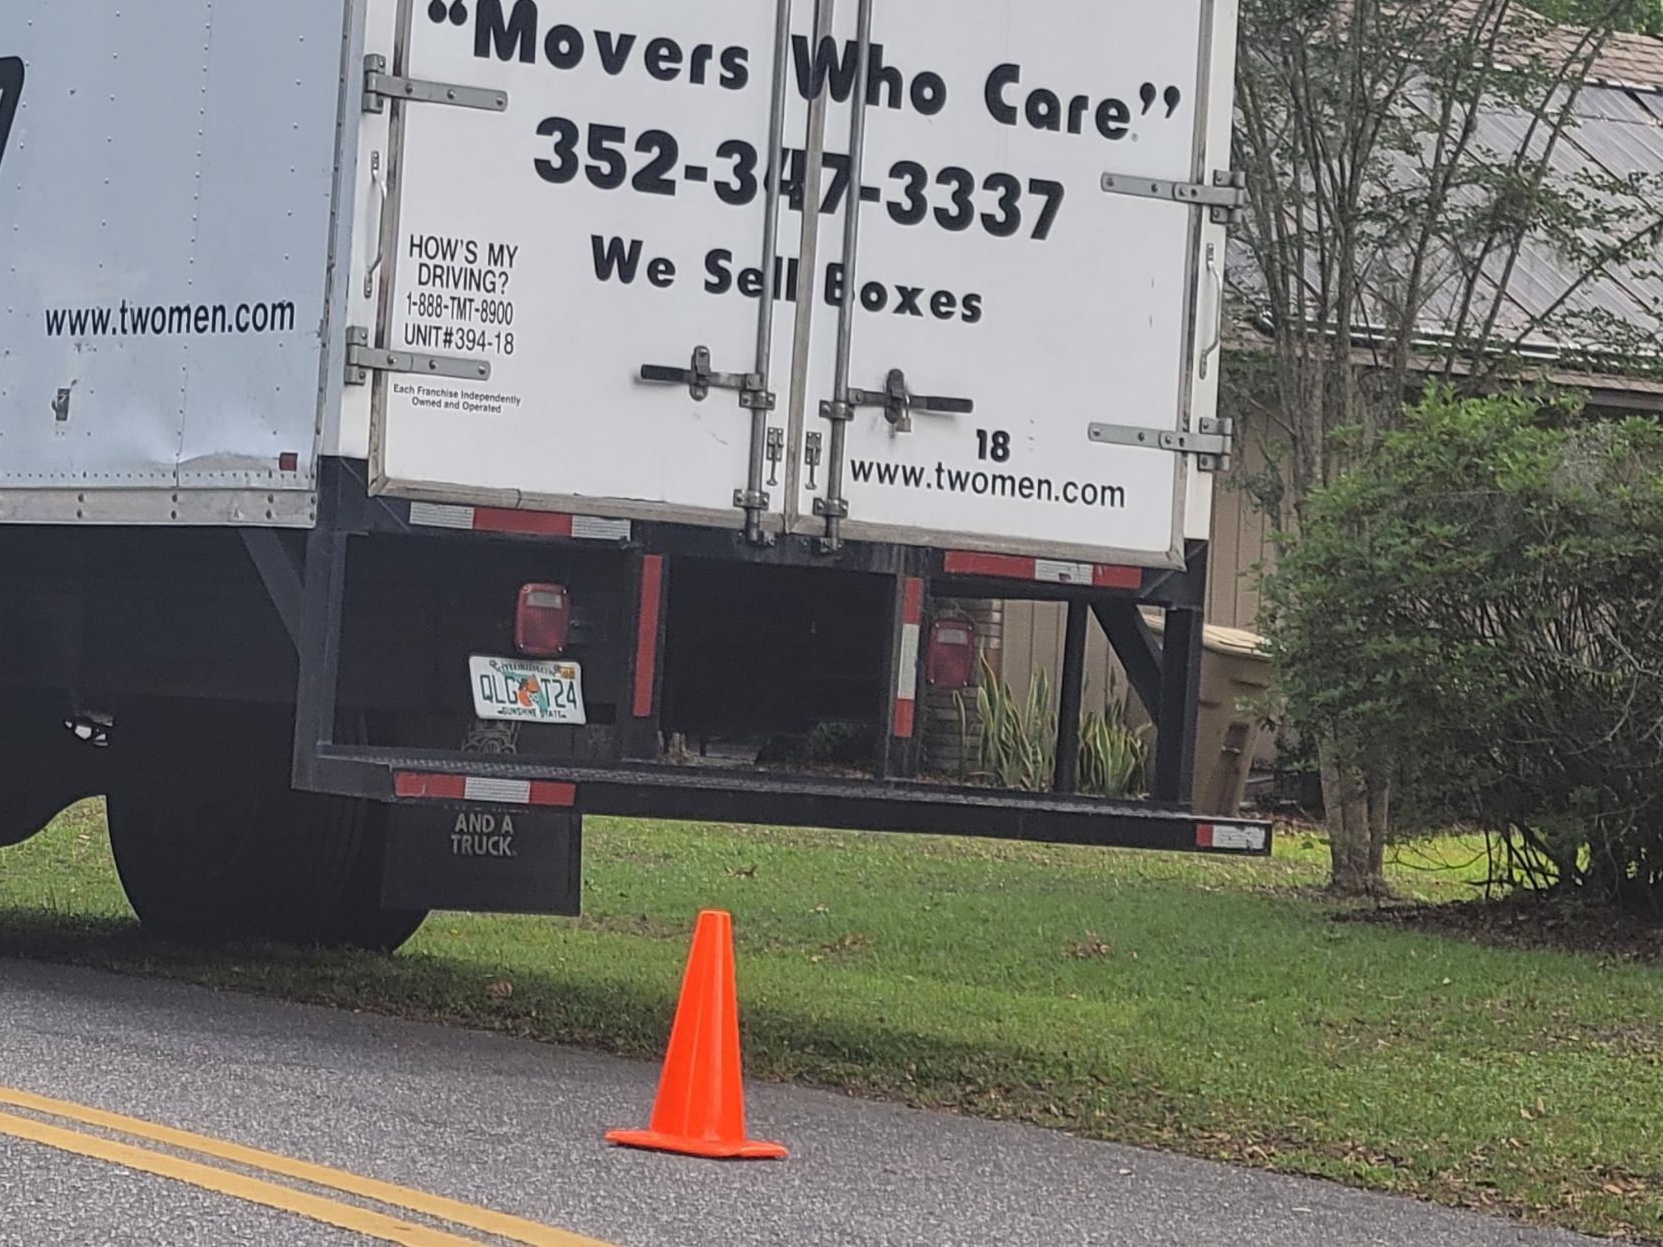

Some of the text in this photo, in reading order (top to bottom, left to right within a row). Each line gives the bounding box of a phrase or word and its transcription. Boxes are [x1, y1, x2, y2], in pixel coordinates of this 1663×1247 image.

[791, 34, 947, 116] Who
[534, 117, 1065, 241] 352-347-3337
[409, 234, 519, 269] HOW'S MY
[418, 262, 509, 295] DRIVING?
[591, 235, 982, 324] We Sell Boxes
[45, 296, 295, 337] www.twomen.com
[406, 291, 514, 326] 1-888-TMT-8900
[404, 322, 515, 355] UNIT#394-18
[393, 384, 521, 406] Each Franchise Independently
[412, 397, 501, 413] Owned and Operated
[975, 429, 1011, 464] 18
[849, 458, 1127, 509] www.twomen.com
[455, 812, 514, 834] AND A
[451, 834, 512, 856] TRUCK
